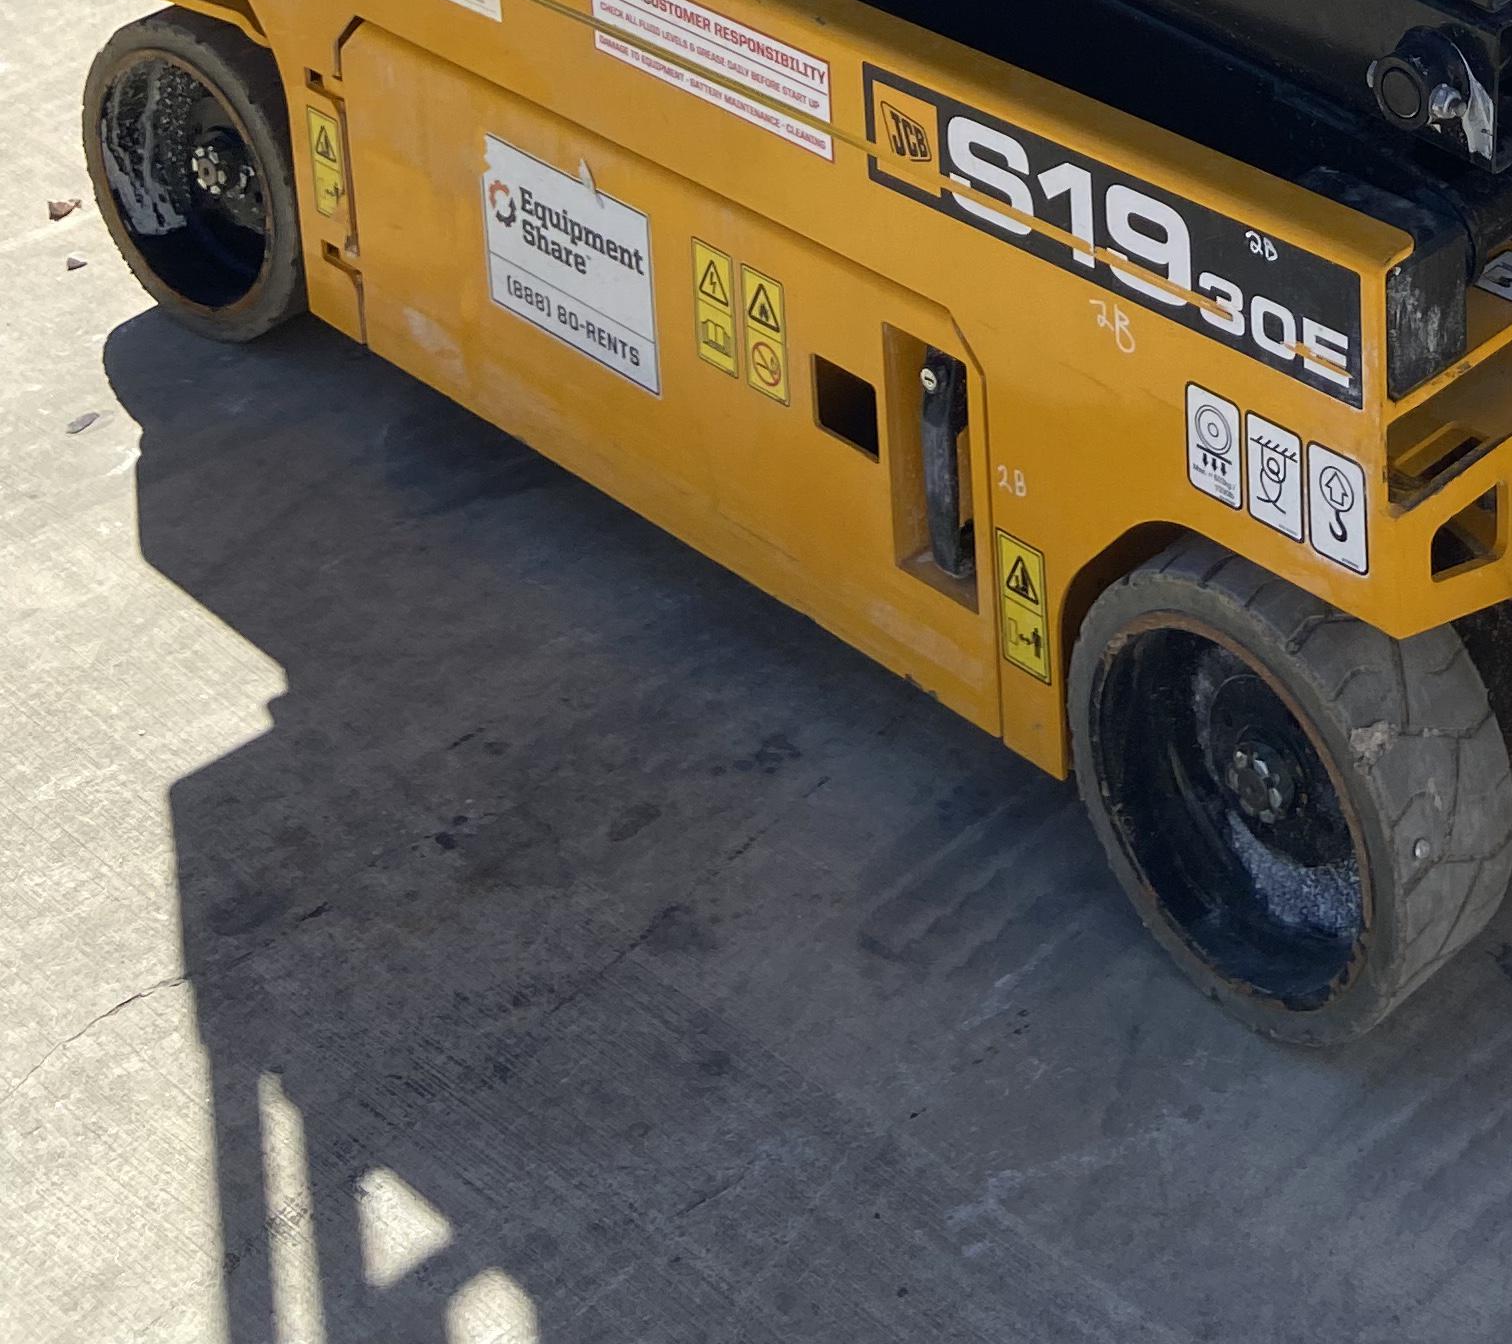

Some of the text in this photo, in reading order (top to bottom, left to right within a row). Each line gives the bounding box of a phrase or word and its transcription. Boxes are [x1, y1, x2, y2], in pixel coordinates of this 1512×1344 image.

[598, 32, 629, 57] DAMAGE
[630, 48, 640, 62] TO
[640, 53, 685, 84] EQUIPMENT
[689, 76, 723, 102] BATTERY
[724, 92, 780, 129] MAINTENANCE
[785, 121, 826, 152] CLEANING
[599, 0, 624, 21] CHECK
[624, 11, 638, 27] ALL
[661, 28, 688, 50] LEVELS
[696, 44, 726, 68] GREASE
[726, 58, 749, 79] DAILY
[750, 70, 780, 93] BEFORE
[781, 84, 806, 106] START
[808, 97, 820, 112] UP
[713, 20, 825, 86] RESPONSIBILITY
[890, 110, 928, 158] JCB
[519, 184, 644, 276] Equipment
[522, 218, 588, 275] Share
[506, 274, 640, 367] (888) 80-RENTS
